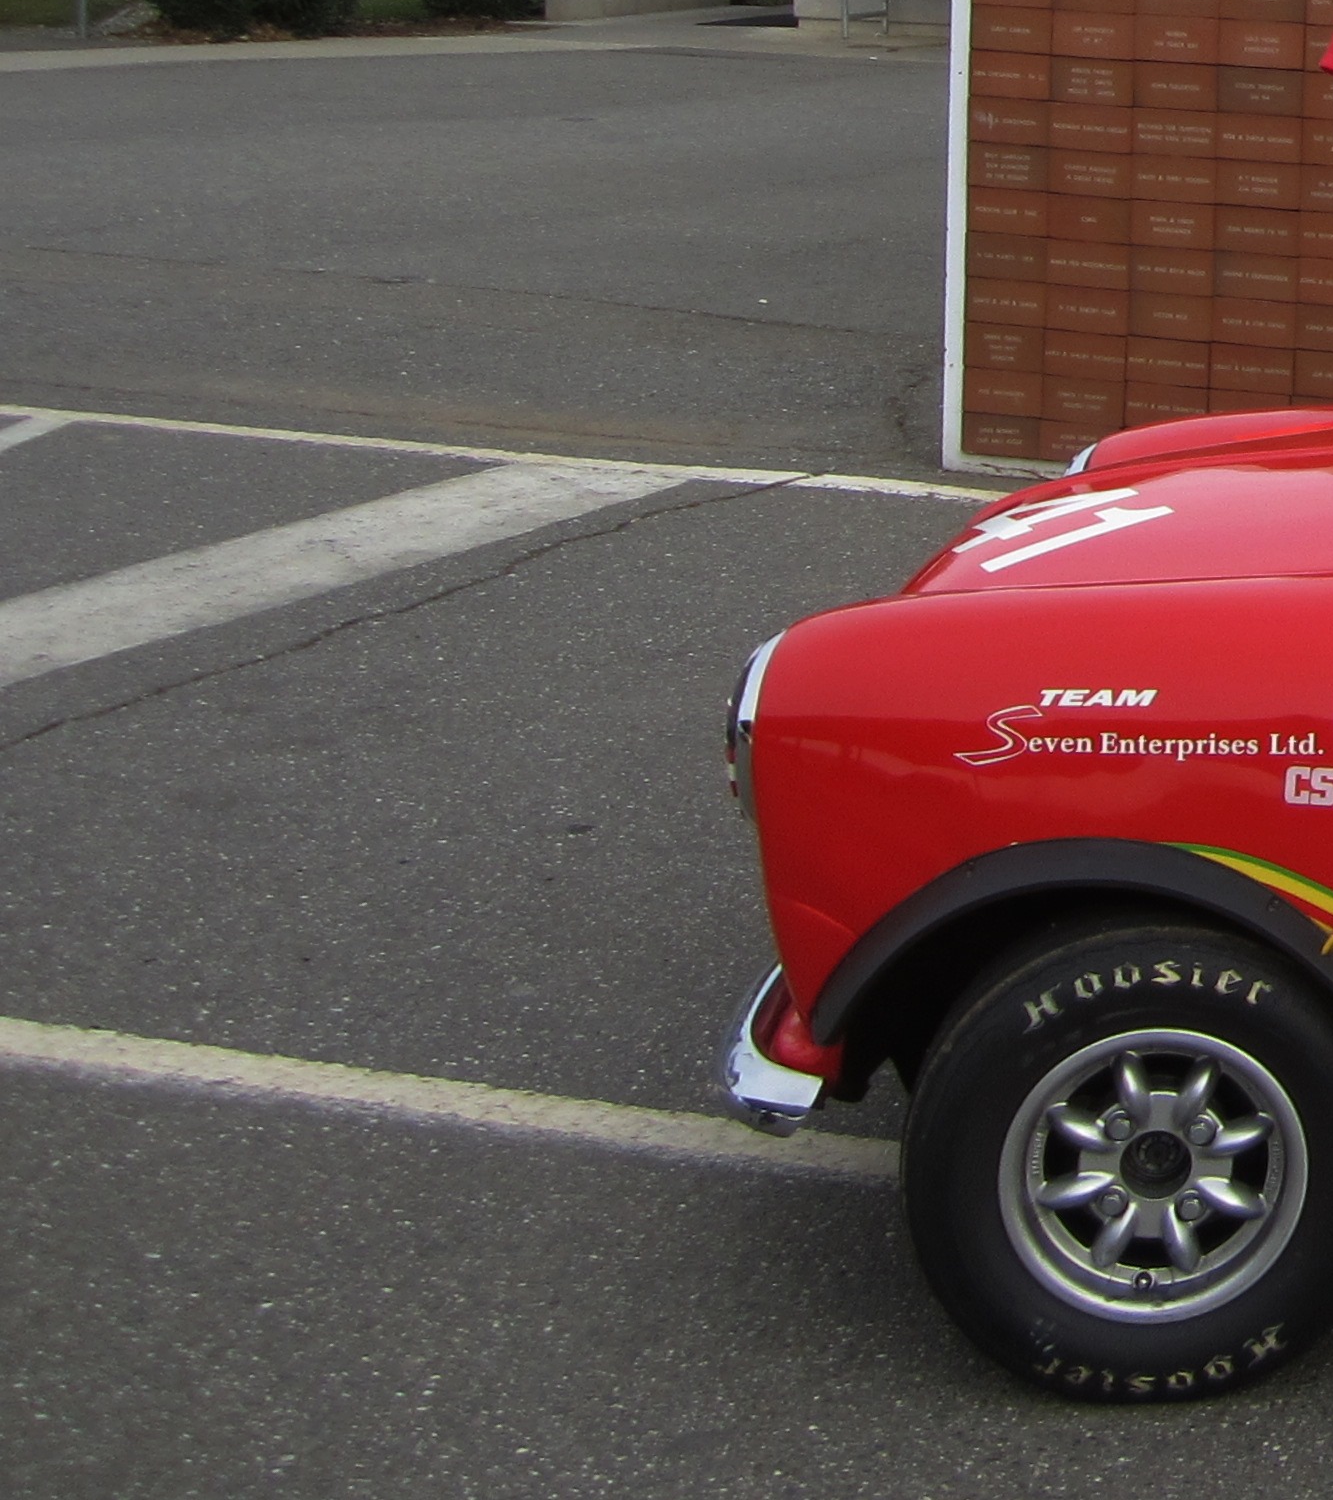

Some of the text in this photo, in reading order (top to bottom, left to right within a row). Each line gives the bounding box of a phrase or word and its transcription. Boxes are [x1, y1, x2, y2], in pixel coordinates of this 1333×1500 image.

[951, 487, 1175, 573] 41
[1039, 689, 1159, 707] TEAM
[953, 705, 1324, 766] Seven Enterprises Ltd.
[1022, 960, 1274, 1035] Hoosier
